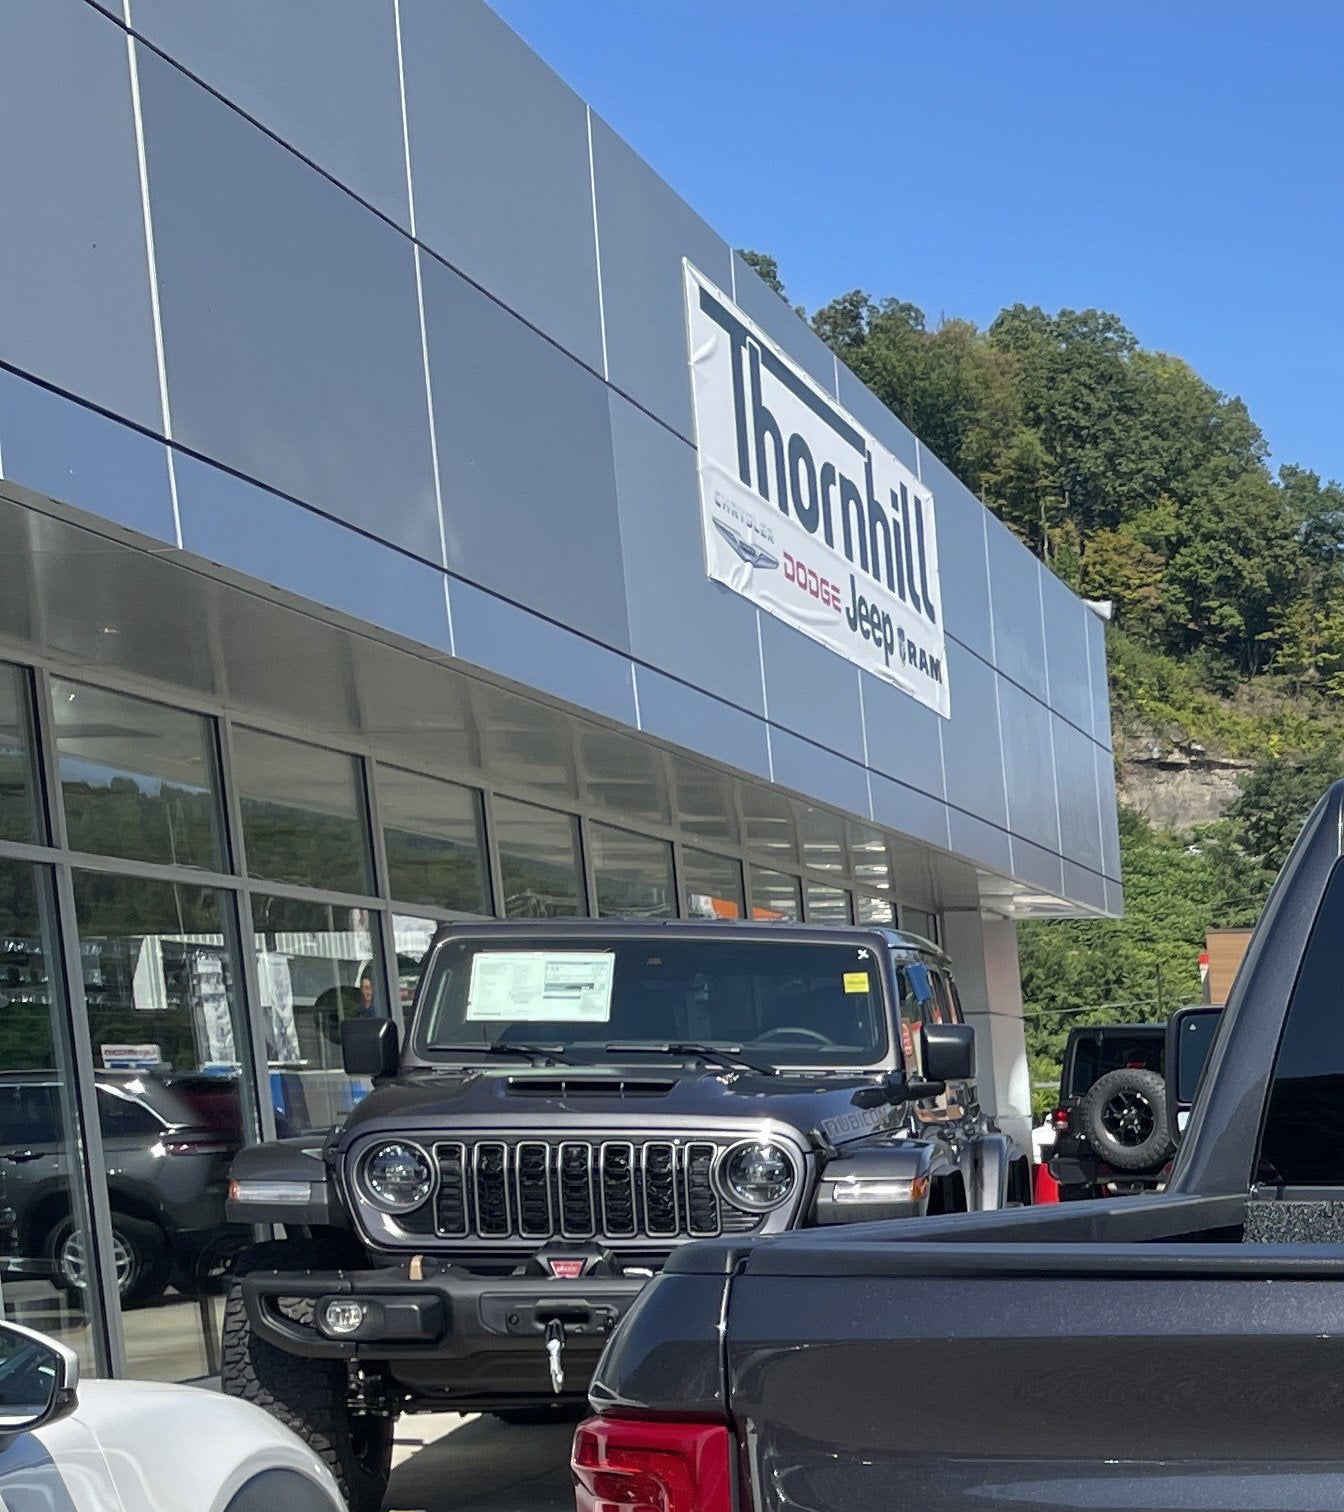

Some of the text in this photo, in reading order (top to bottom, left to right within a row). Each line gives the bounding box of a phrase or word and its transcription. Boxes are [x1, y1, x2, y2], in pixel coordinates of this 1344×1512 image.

[699, 284, 936, 625] Thornhill
[782, 550, 842, 613] DODGE
[845, 573, 894, 668] Jeep
[906, 637, 943, 684] RAM
